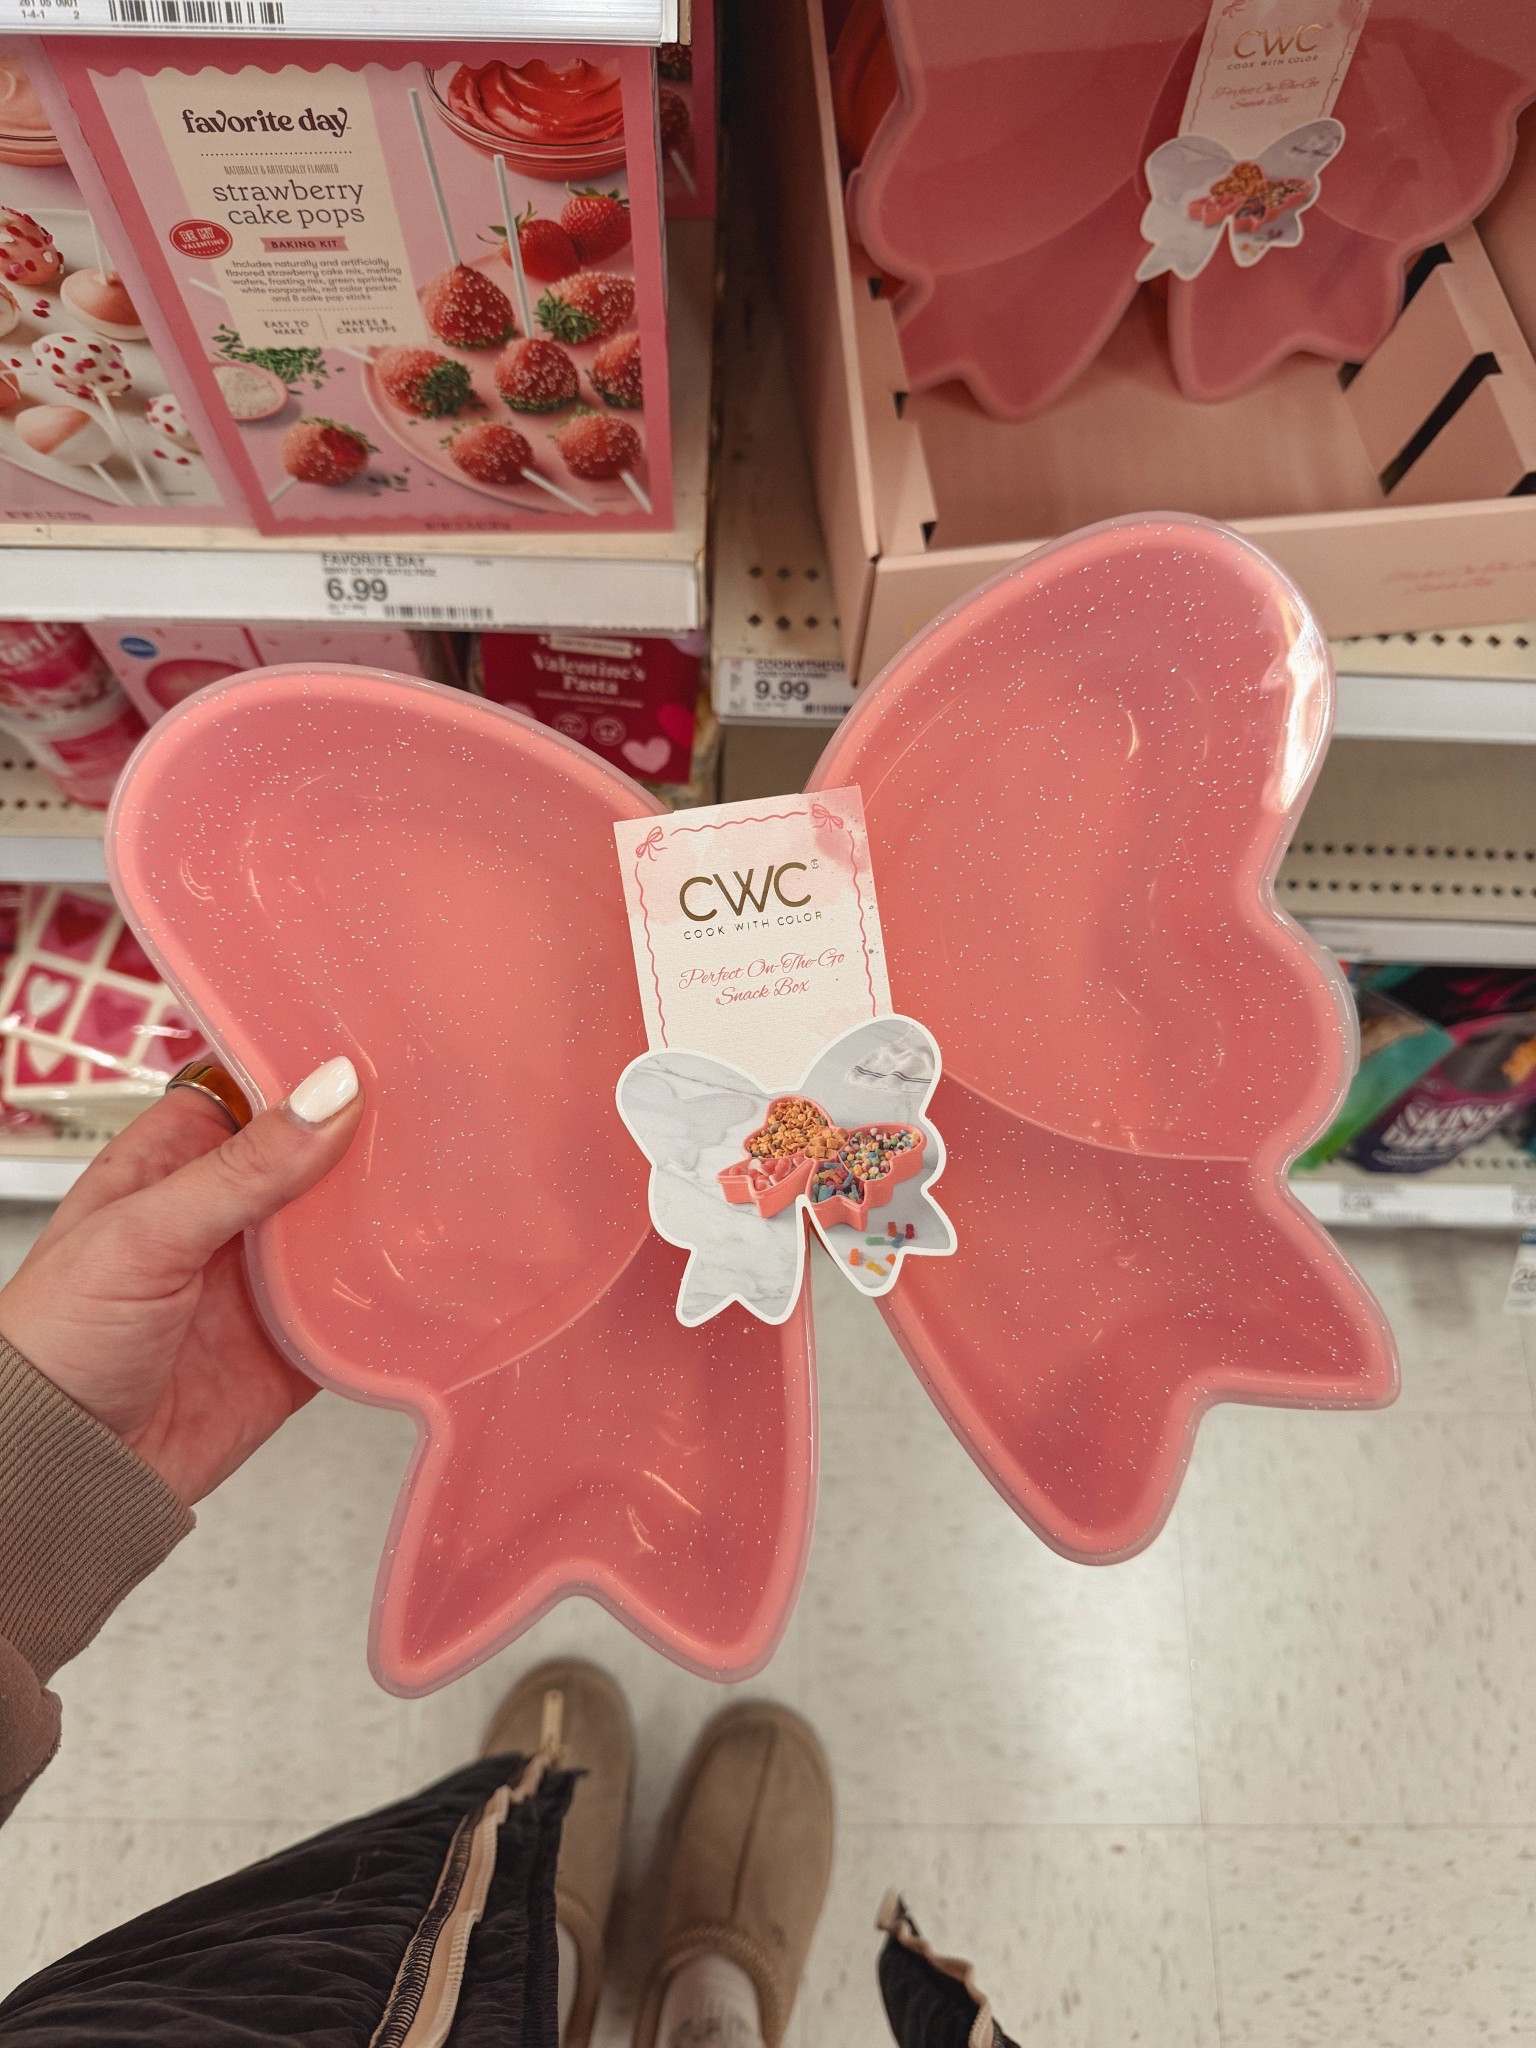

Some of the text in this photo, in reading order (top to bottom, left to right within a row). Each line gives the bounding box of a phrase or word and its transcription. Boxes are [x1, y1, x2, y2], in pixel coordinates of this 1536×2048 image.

[22, 9, 80, 20] 1-4-1 2
[1234, 23, 1323, 59] CWC
[1227, 55, 1319, 70] COOK WITH COLOR
[182, 107, 348, 138] favorite day
[223, 163, 340, 176] NATURALLY & ARTIFICIALLY FLAVORED
[213, 179, 364, 205] strawberry
[228, 204, 365, 229] cake pops
[179, 226, 216, 242] BE MY
[181, 238, 225, 250] VALENTINE
[271, 240, 338, 249] BAKING KIT
[225, 269, 265, 277] flavored
[267, 269, 320, 280] strawberry
[320, 268, 344, 276] cake
[366, 267, 403, 276] melting
[232, 258, 390, 270] Includes naturally and artificially
[268, 278, 306, 287] frosting
[328, 278, 356, 287] green
[293, 320, 310, 328] TO
[327, 578, 388, 602] 6.99
[531, 652, 646, 682] Valentine's
[562, 675, 619, 696] Pasta
[755, 680, 809, 701] 9.99
[683, 911, 822, 940] COOK WITH COLOR
[678, 948, 846, 990] Perfect On-The-Go
[716, 977, 810, 1006] Snack Box
